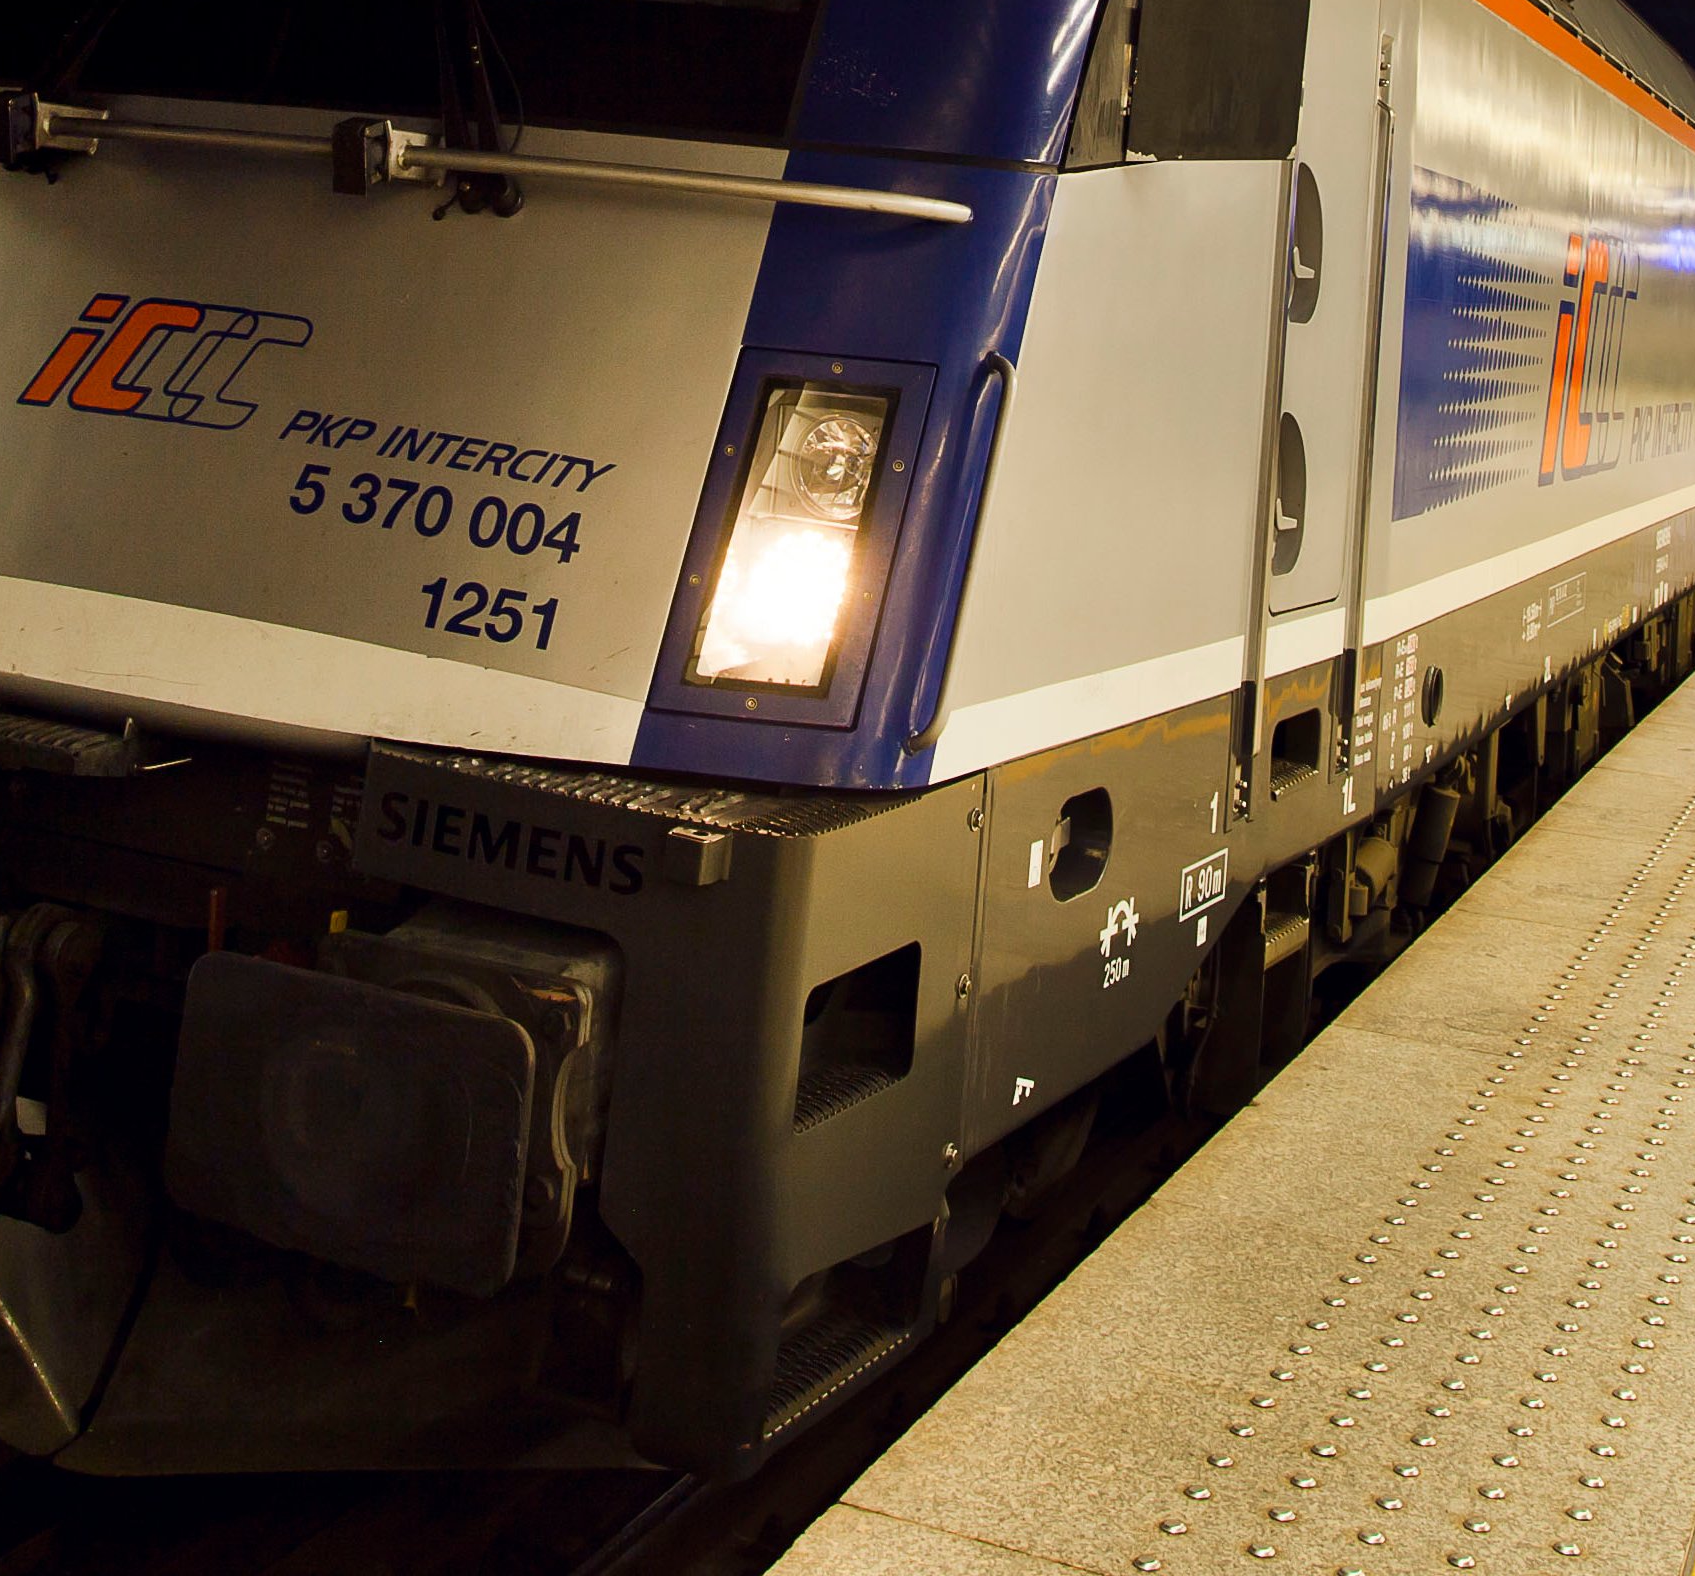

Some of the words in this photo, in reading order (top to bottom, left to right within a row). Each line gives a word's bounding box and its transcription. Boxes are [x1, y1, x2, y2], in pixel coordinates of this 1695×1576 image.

[279, 409, 377, 451] PKP
[375, 425, 617, 494] INTERCITY
[289, 462, 332, 516] 5
[341, 471, 454, 538] 370
[468, 494, 583, 565] 004
[420, 576, 561, 652] 1251
[1209, 791, 1219, 834] 1
[1342, 775, 1356, 816] 1L
[378, 790, 646, 896] SIEMENS
[1184, 874, 1193, 910] R
